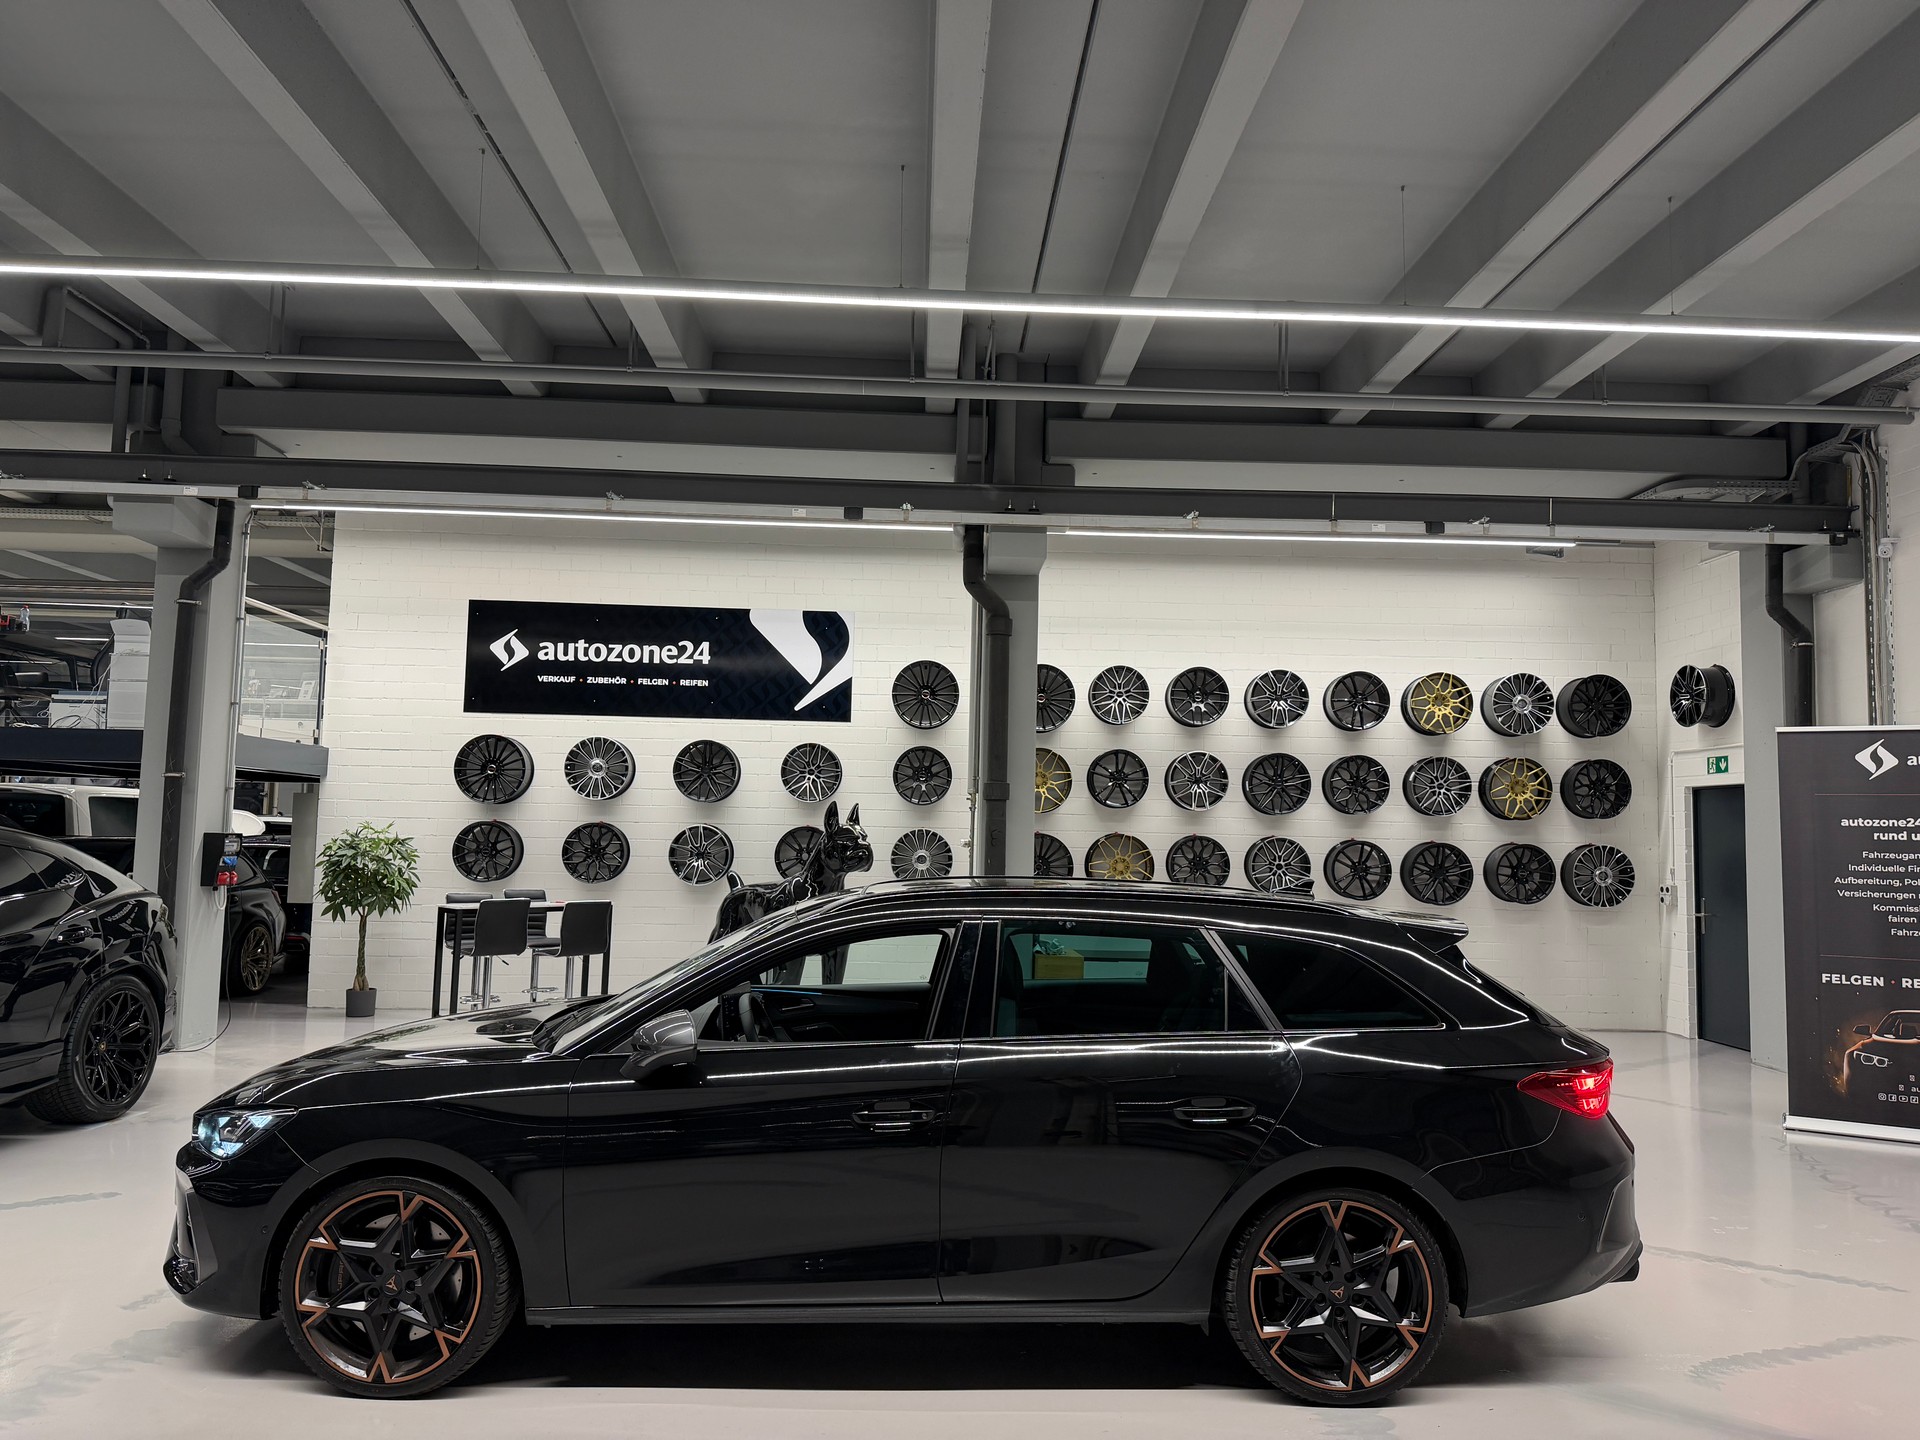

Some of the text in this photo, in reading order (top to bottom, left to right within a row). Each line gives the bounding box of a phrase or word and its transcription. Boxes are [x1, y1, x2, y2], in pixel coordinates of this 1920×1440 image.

[538, 639, 710, 664] autozone24
[536, 674, 709, 687] VERKAUF ZUBEHÖR FELGEN REIFEN
[1873, 830, 1908, 841] rund
[1848, 863, 1906, 873] Individuelle
[1833, 876, 1903, 888] Aufbereitung,
[1836, 889, 1916, 901] Versicherungen
[1887, 914, 1917, 924] fairen
[1890, 928, 1920, 937] Fahrz
[1822, 974, 1920, 988] FELGEN RE
